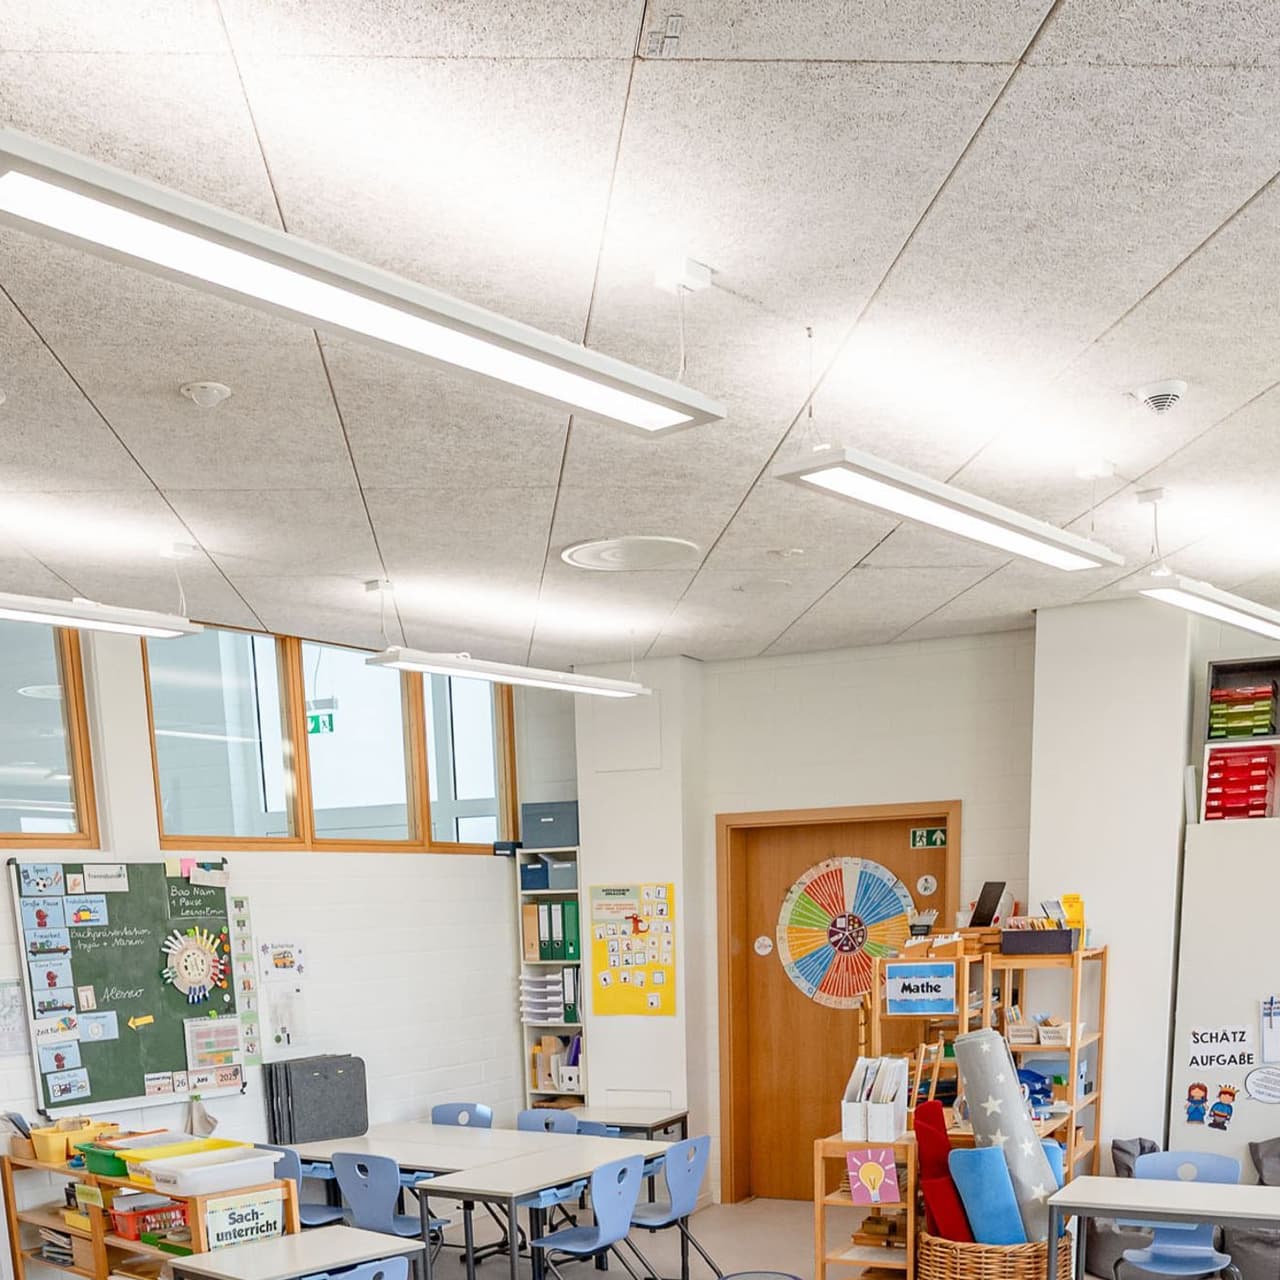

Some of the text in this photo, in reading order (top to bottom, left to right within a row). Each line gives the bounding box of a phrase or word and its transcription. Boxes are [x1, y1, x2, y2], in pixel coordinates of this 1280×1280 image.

[900, 981, 942, 995] Mathe
[1192, 1028, 1247, 1044] SCHÄTZ
[1189, 1053, 1255, 1067] AUFGABE
[228, 1208, 265, 1226] Sach-
[216, 1219, 278, 1243] unterricht
